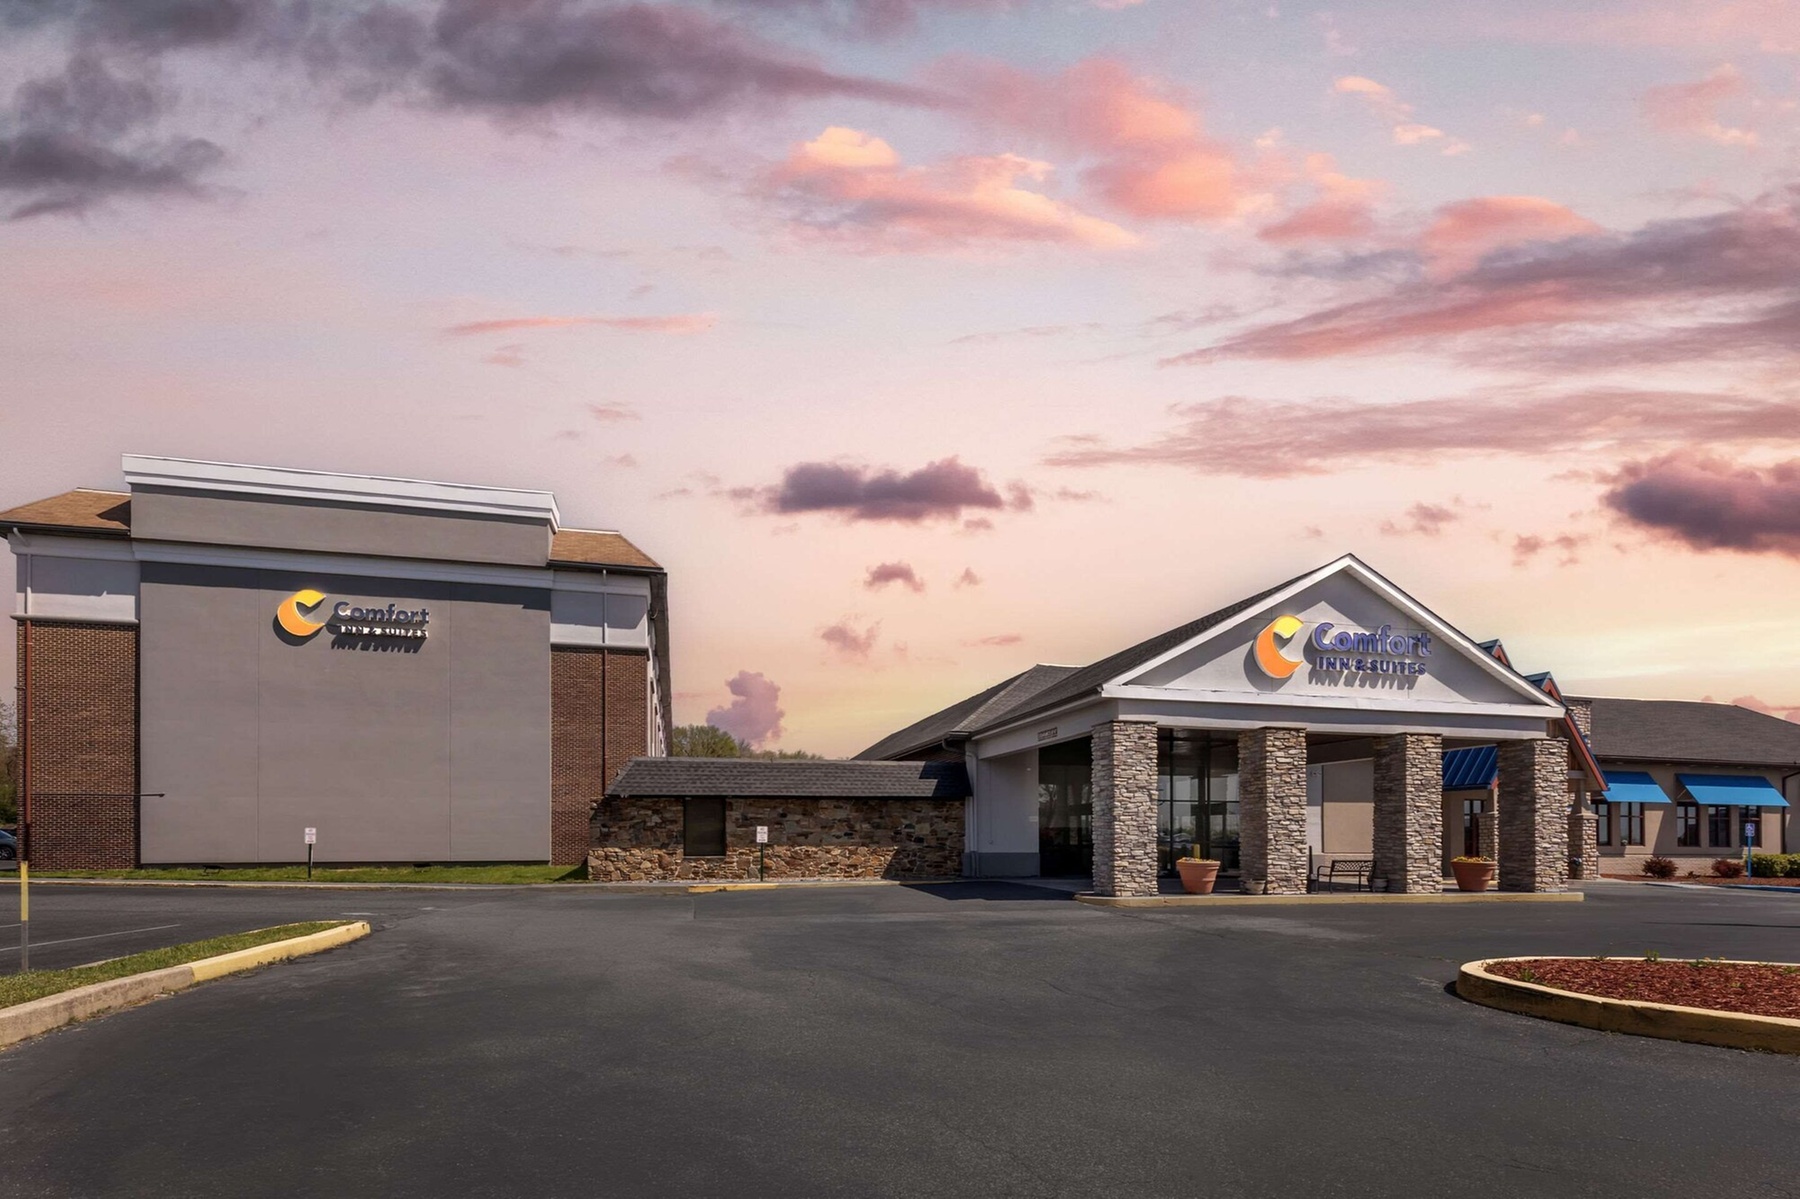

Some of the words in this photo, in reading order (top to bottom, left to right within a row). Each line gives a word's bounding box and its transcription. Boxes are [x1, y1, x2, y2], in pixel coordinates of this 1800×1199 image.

[333, 601, 429, 624] Comfort
[1312, 622, 1432, 656] Comfort
[1317, 656, 1351, 671] INN
[1353, 658, 1367, 672] &
[1368, 659, 1427, 676] SUITES
